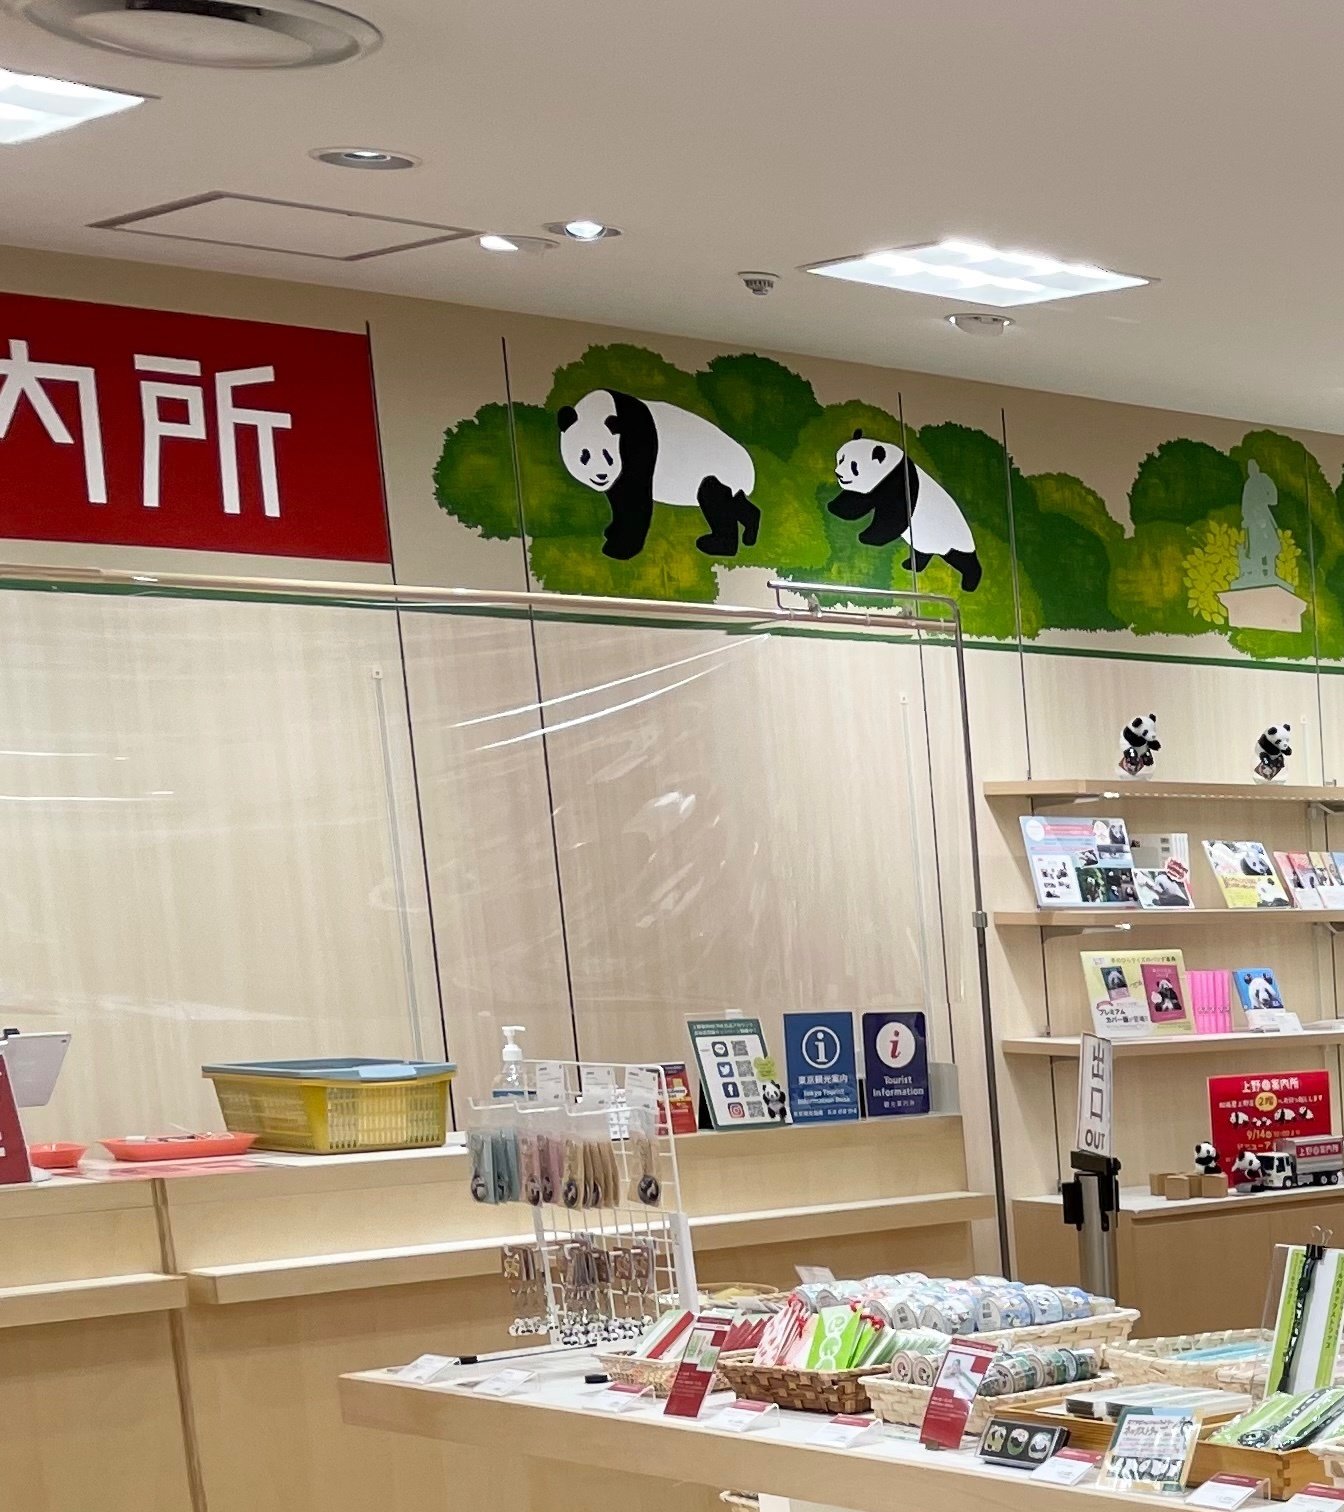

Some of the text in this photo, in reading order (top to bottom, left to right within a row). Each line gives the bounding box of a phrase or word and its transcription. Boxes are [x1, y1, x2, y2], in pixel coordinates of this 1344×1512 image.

[883, 1075, 912, 1085] Tourist
[1090, 1042, 1105, 1122] 出口
[872, 1087, 924, 1098] Information
[1085, 1129, 1105, 1150] OUT
